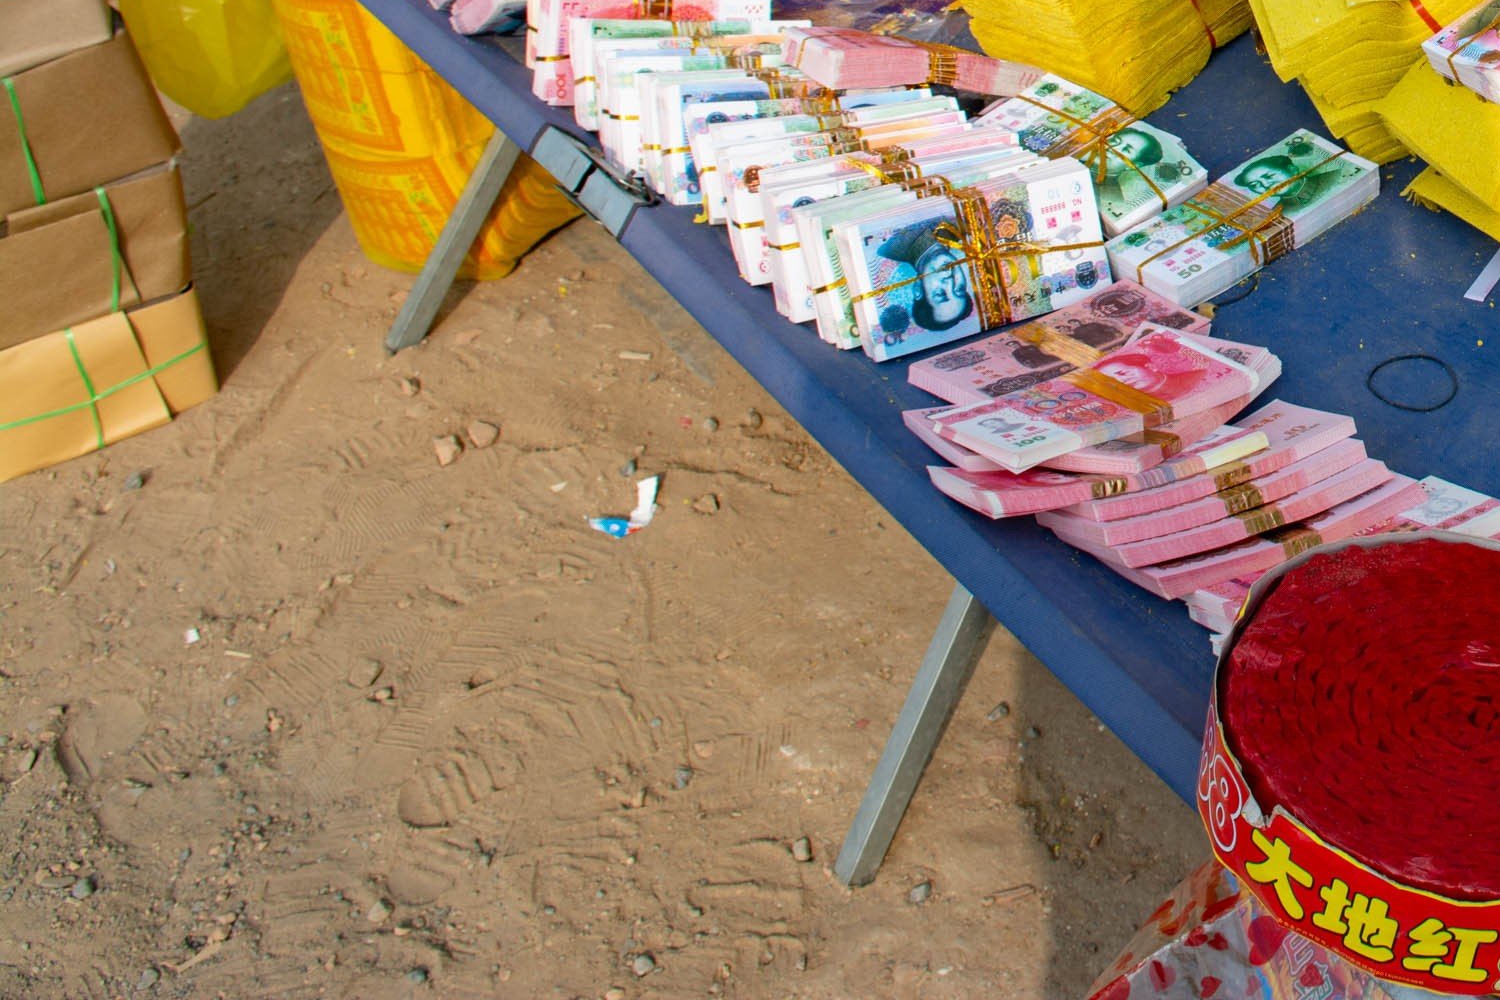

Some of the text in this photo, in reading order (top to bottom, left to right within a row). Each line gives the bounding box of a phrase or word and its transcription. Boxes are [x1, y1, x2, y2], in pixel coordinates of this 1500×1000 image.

[1176, 263, 1203, 280] 50
[1013, 434, 1048, 449] 100
[1244, 827, 1499, 983] 大地红
